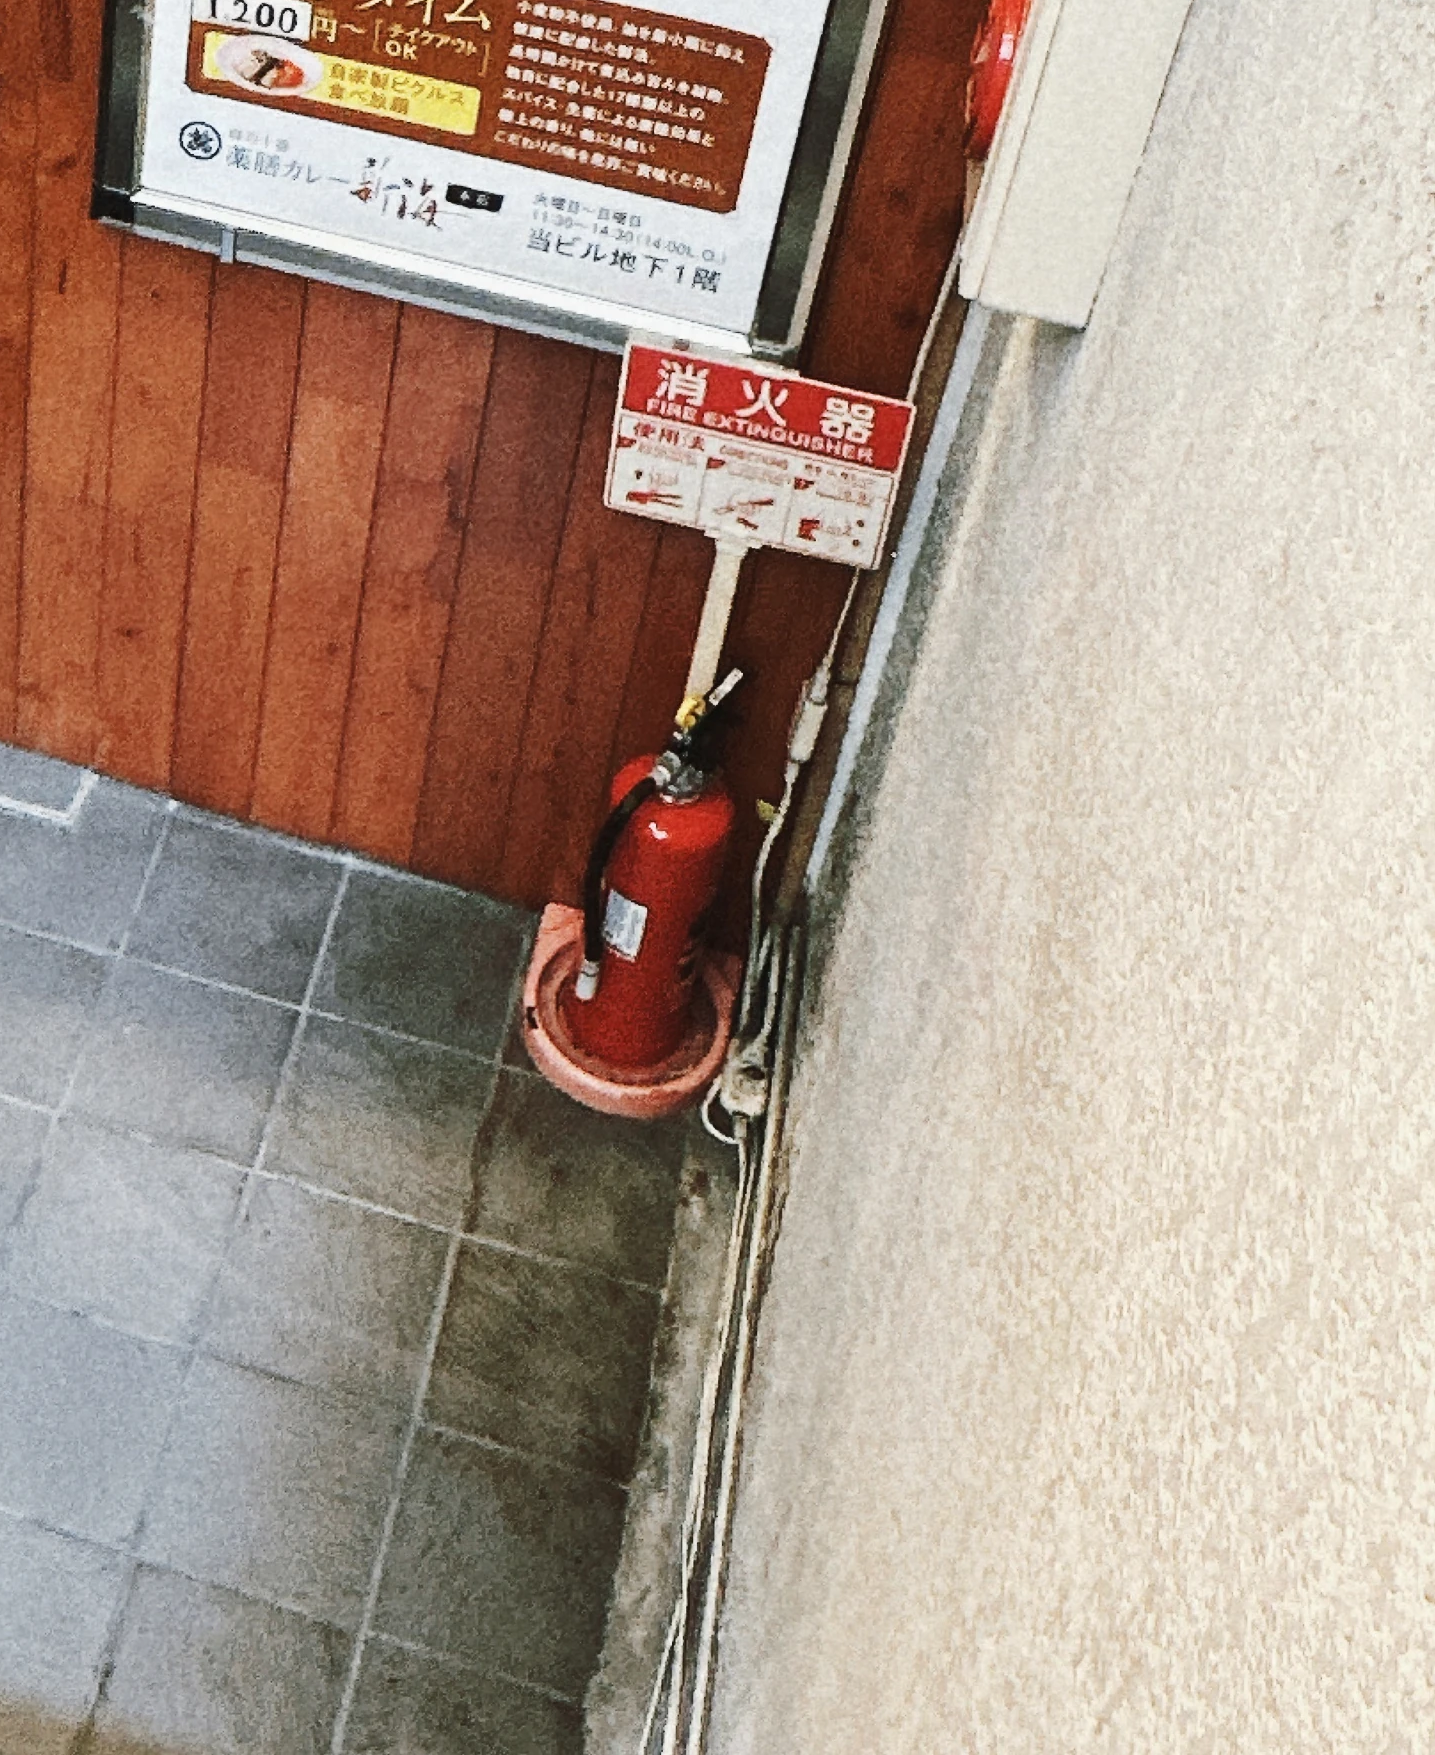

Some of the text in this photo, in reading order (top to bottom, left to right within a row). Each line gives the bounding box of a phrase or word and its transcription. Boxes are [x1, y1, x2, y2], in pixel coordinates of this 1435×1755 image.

[385, 40, 418, 61] OK
[328, 63, 466, 106] 自家製ピクルス
[655, 358, 876, 444] 消火器
[646, 398, 698, 422] FIRE
[703, 411, 874, 466] EXTINGUISHER
